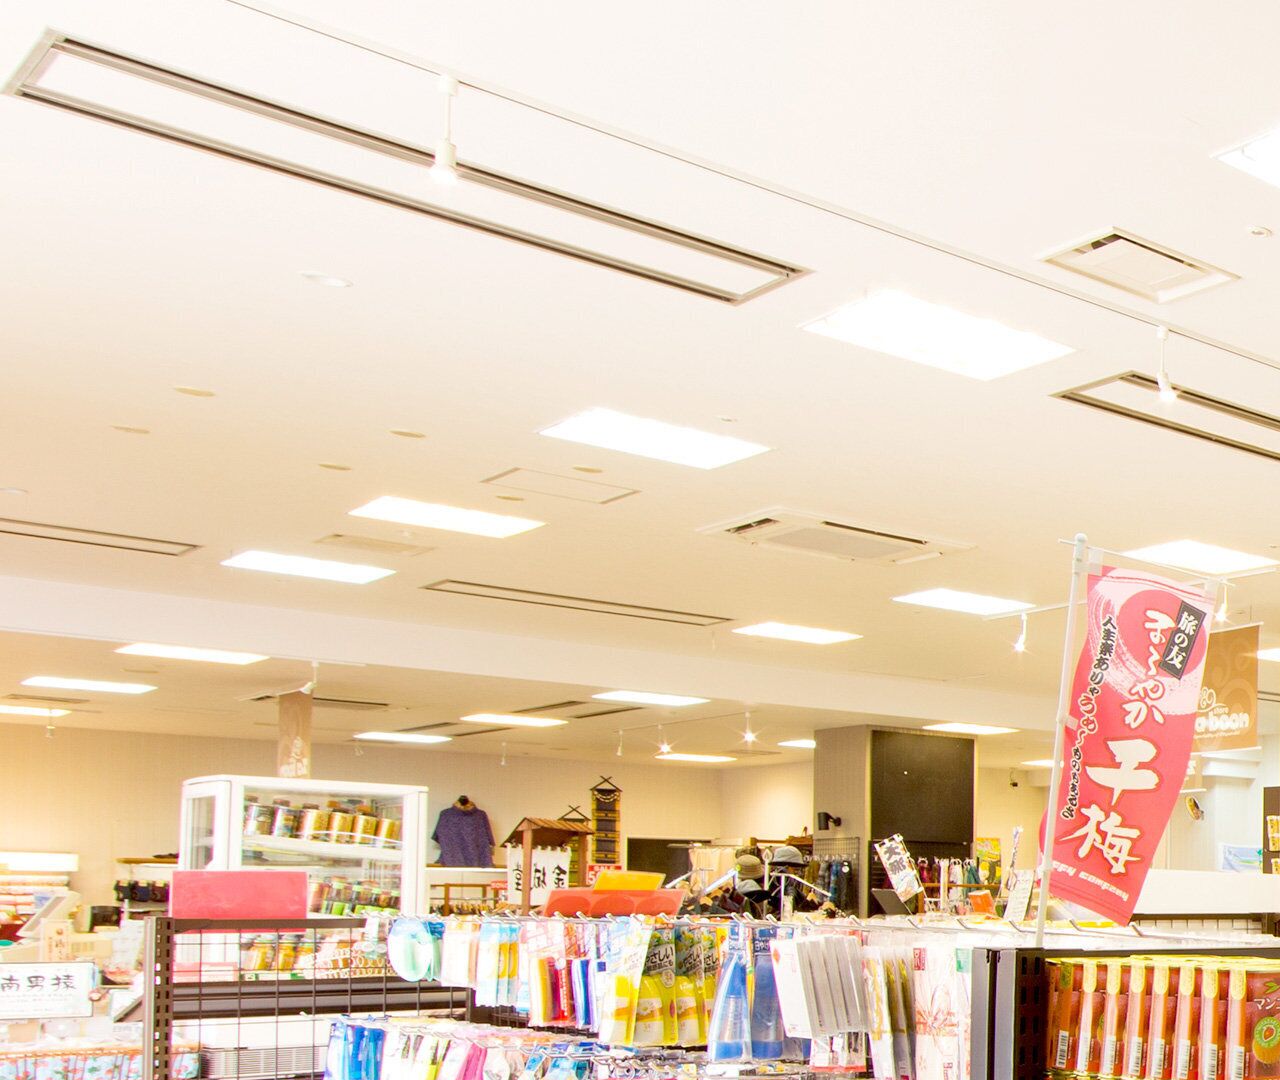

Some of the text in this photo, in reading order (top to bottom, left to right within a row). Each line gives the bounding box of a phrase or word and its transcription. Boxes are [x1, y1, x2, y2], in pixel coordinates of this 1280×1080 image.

[1165, 612, 1199, 669] 旅の友
[1209, 711, 1250, 733] boon
[1057, 739, 1159, 875] 干梅
